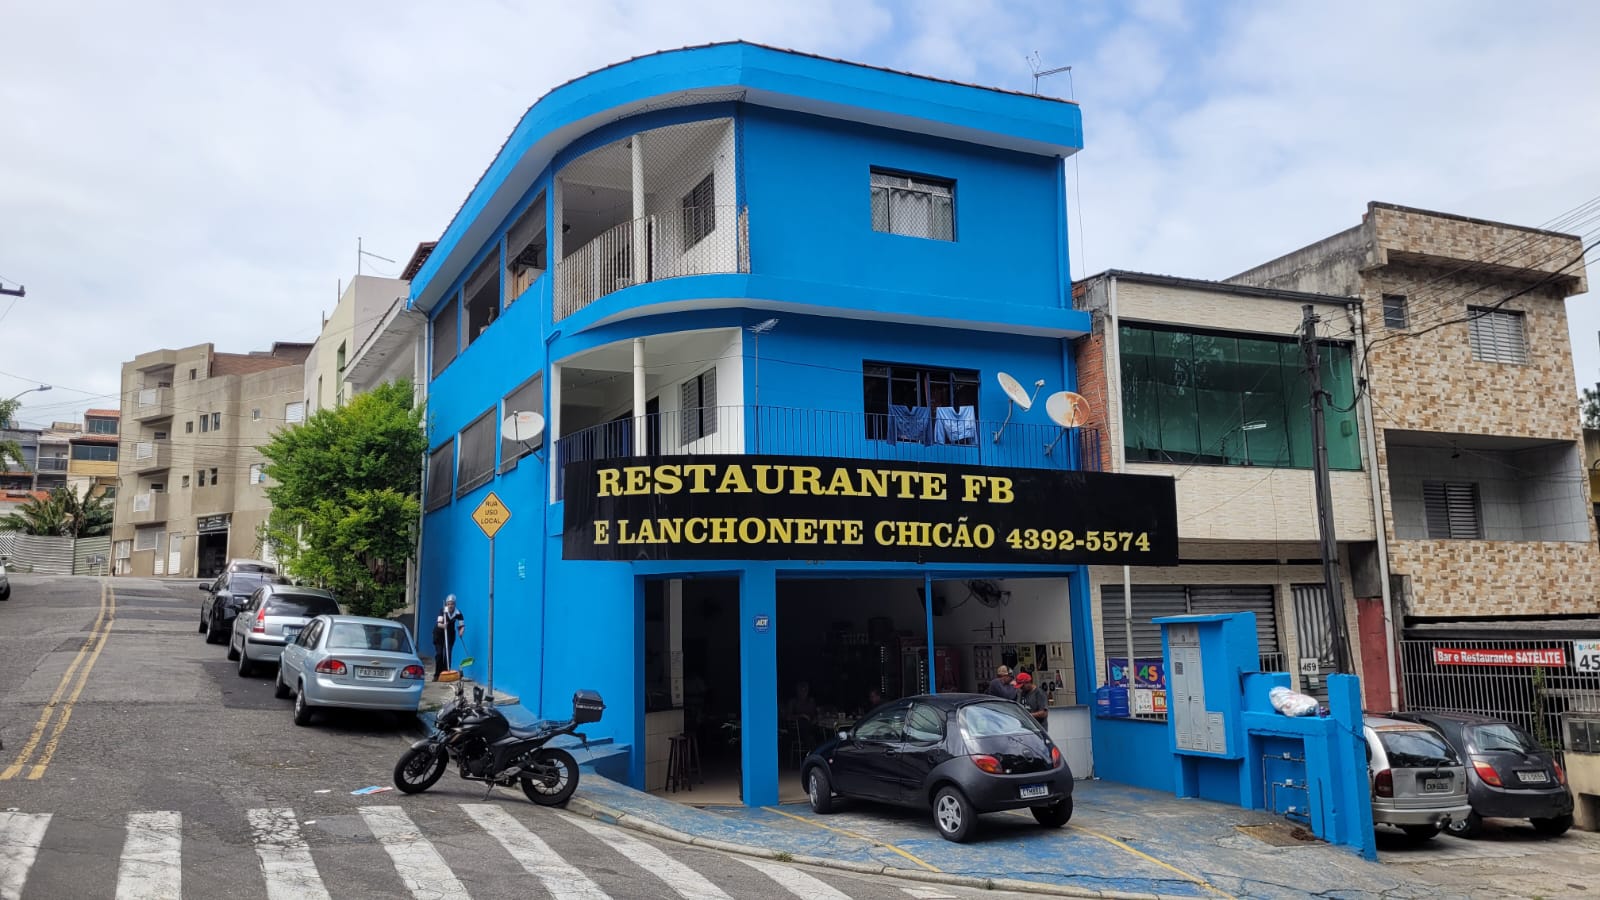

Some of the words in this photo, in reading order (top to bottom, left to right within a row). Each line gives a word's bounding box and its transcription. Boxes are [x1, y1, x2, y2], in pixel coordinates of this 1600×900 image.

[597, 464, 947, 499] RESTAURANTE
[961, 475, 1015, 503] FB
[593, 519, 610, 545] E
[617, 517, 864, 545] LANCHONETE
[874, 515, 996, 549] CHICÃO
[1005, 528, 1151, 552] 4392-5574
[1302, 662, 1317, 672] 459
[1437, 650, 1451, 662] Bar
[1453, 653, 1459, 662] e
[1460, 651, 1513, 664] Restaurante
[1515, 651, 1561, 665] SATELITE
